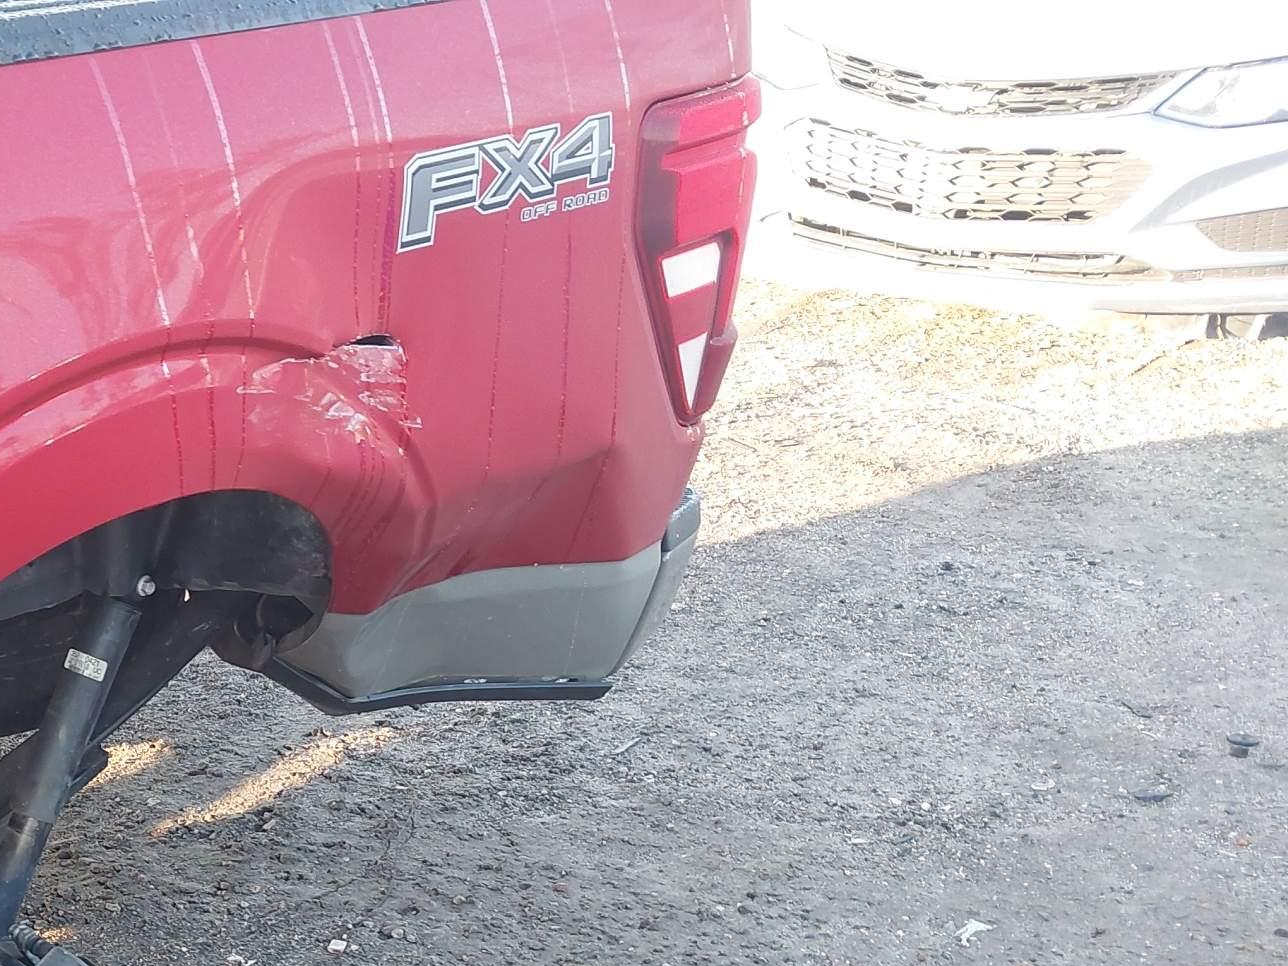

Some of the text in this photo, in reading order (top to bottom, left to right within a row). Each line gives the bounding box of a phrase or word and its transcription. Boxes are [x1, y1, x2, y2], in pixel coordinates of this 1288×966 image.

[396, 111, 615, 254] FX4
[520, 187, 610, 222] OFF ROAD
